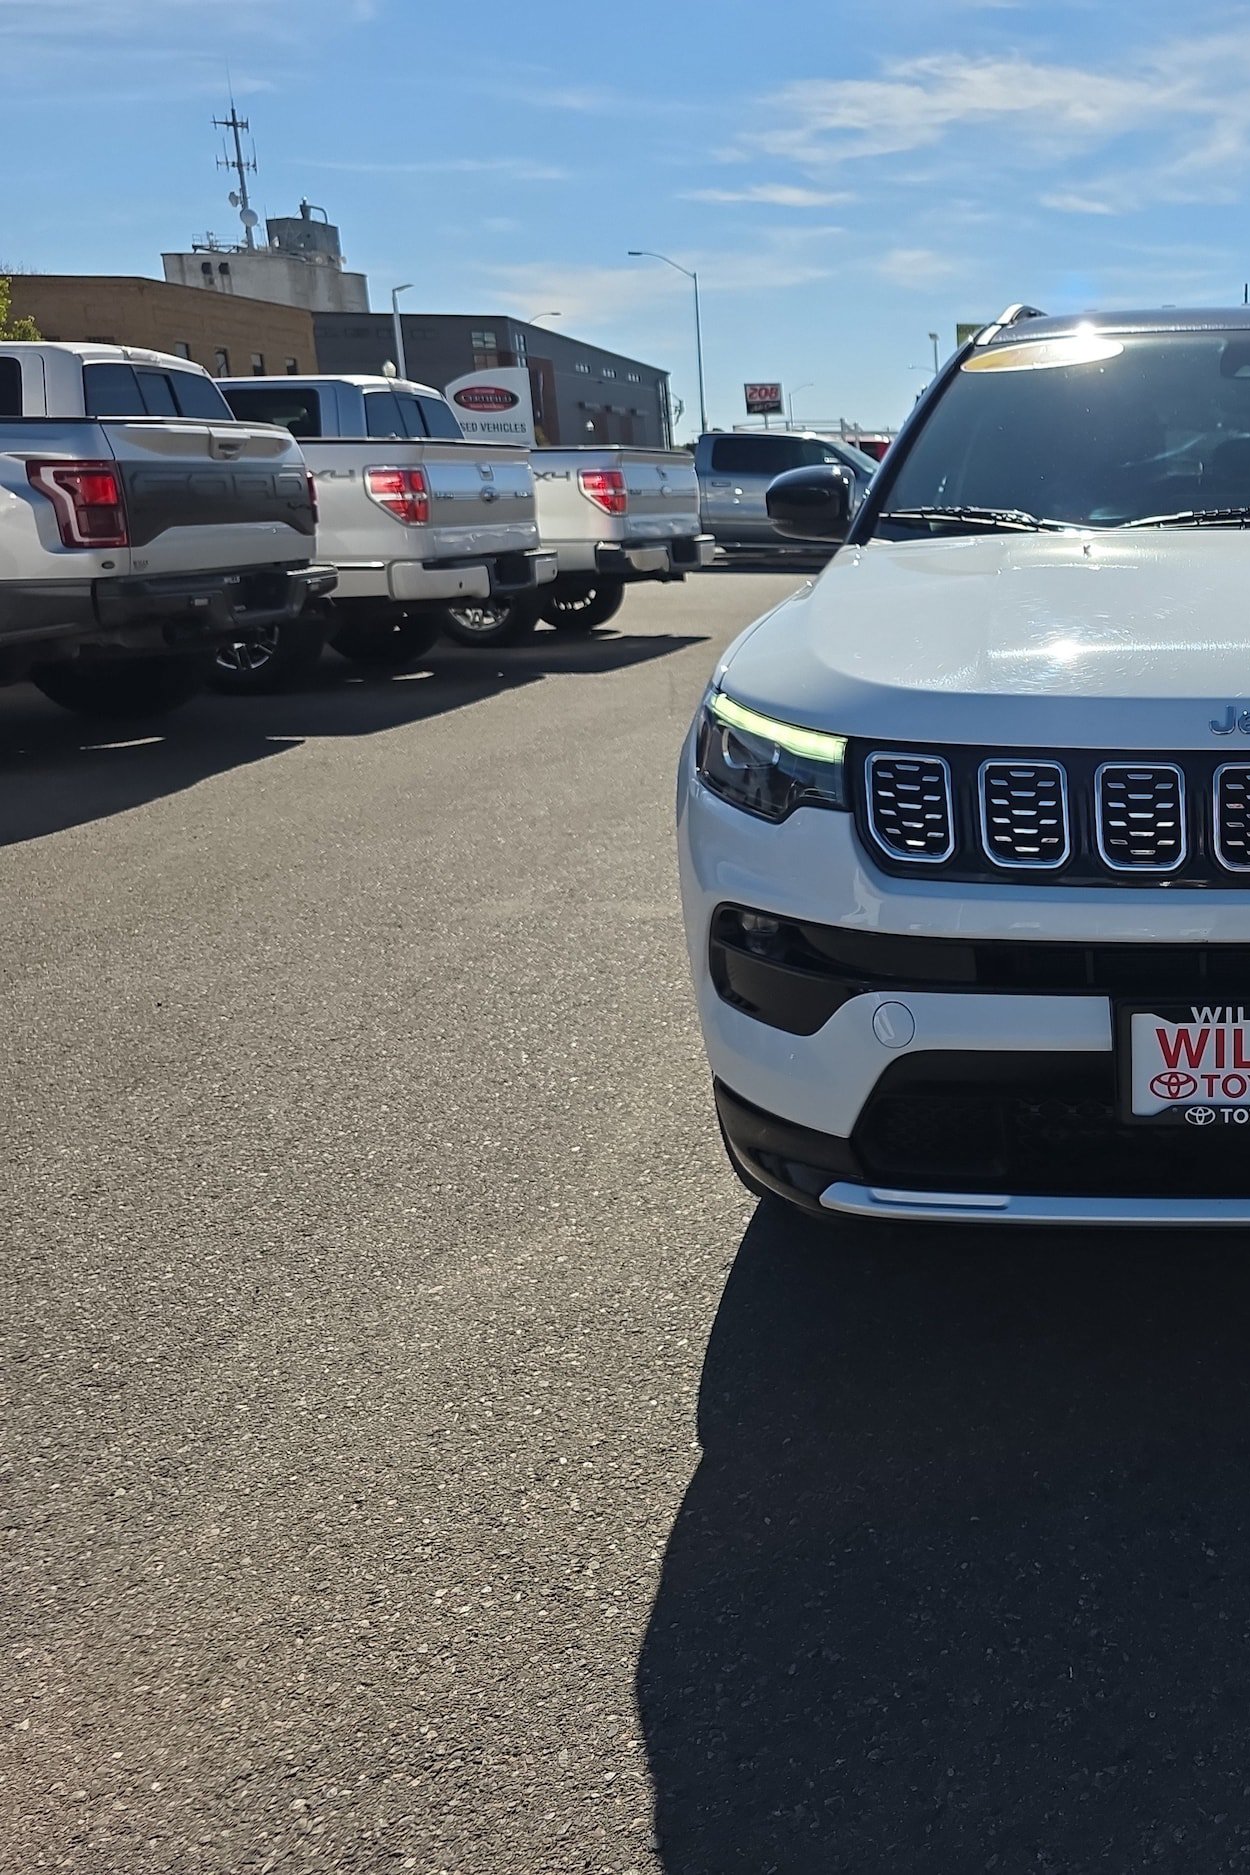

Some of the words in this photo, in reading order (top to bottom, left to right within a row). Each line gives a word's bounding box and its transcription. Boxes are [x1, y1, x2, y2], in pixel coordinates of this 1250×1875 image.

[460, 422, 478, 433] SED
[480, 422, 527, 434] VEHICLES
[315, 469, 356, 482] X4
[533, 472, 570, 482] X4
[130, 471, 302, 499] FORD
